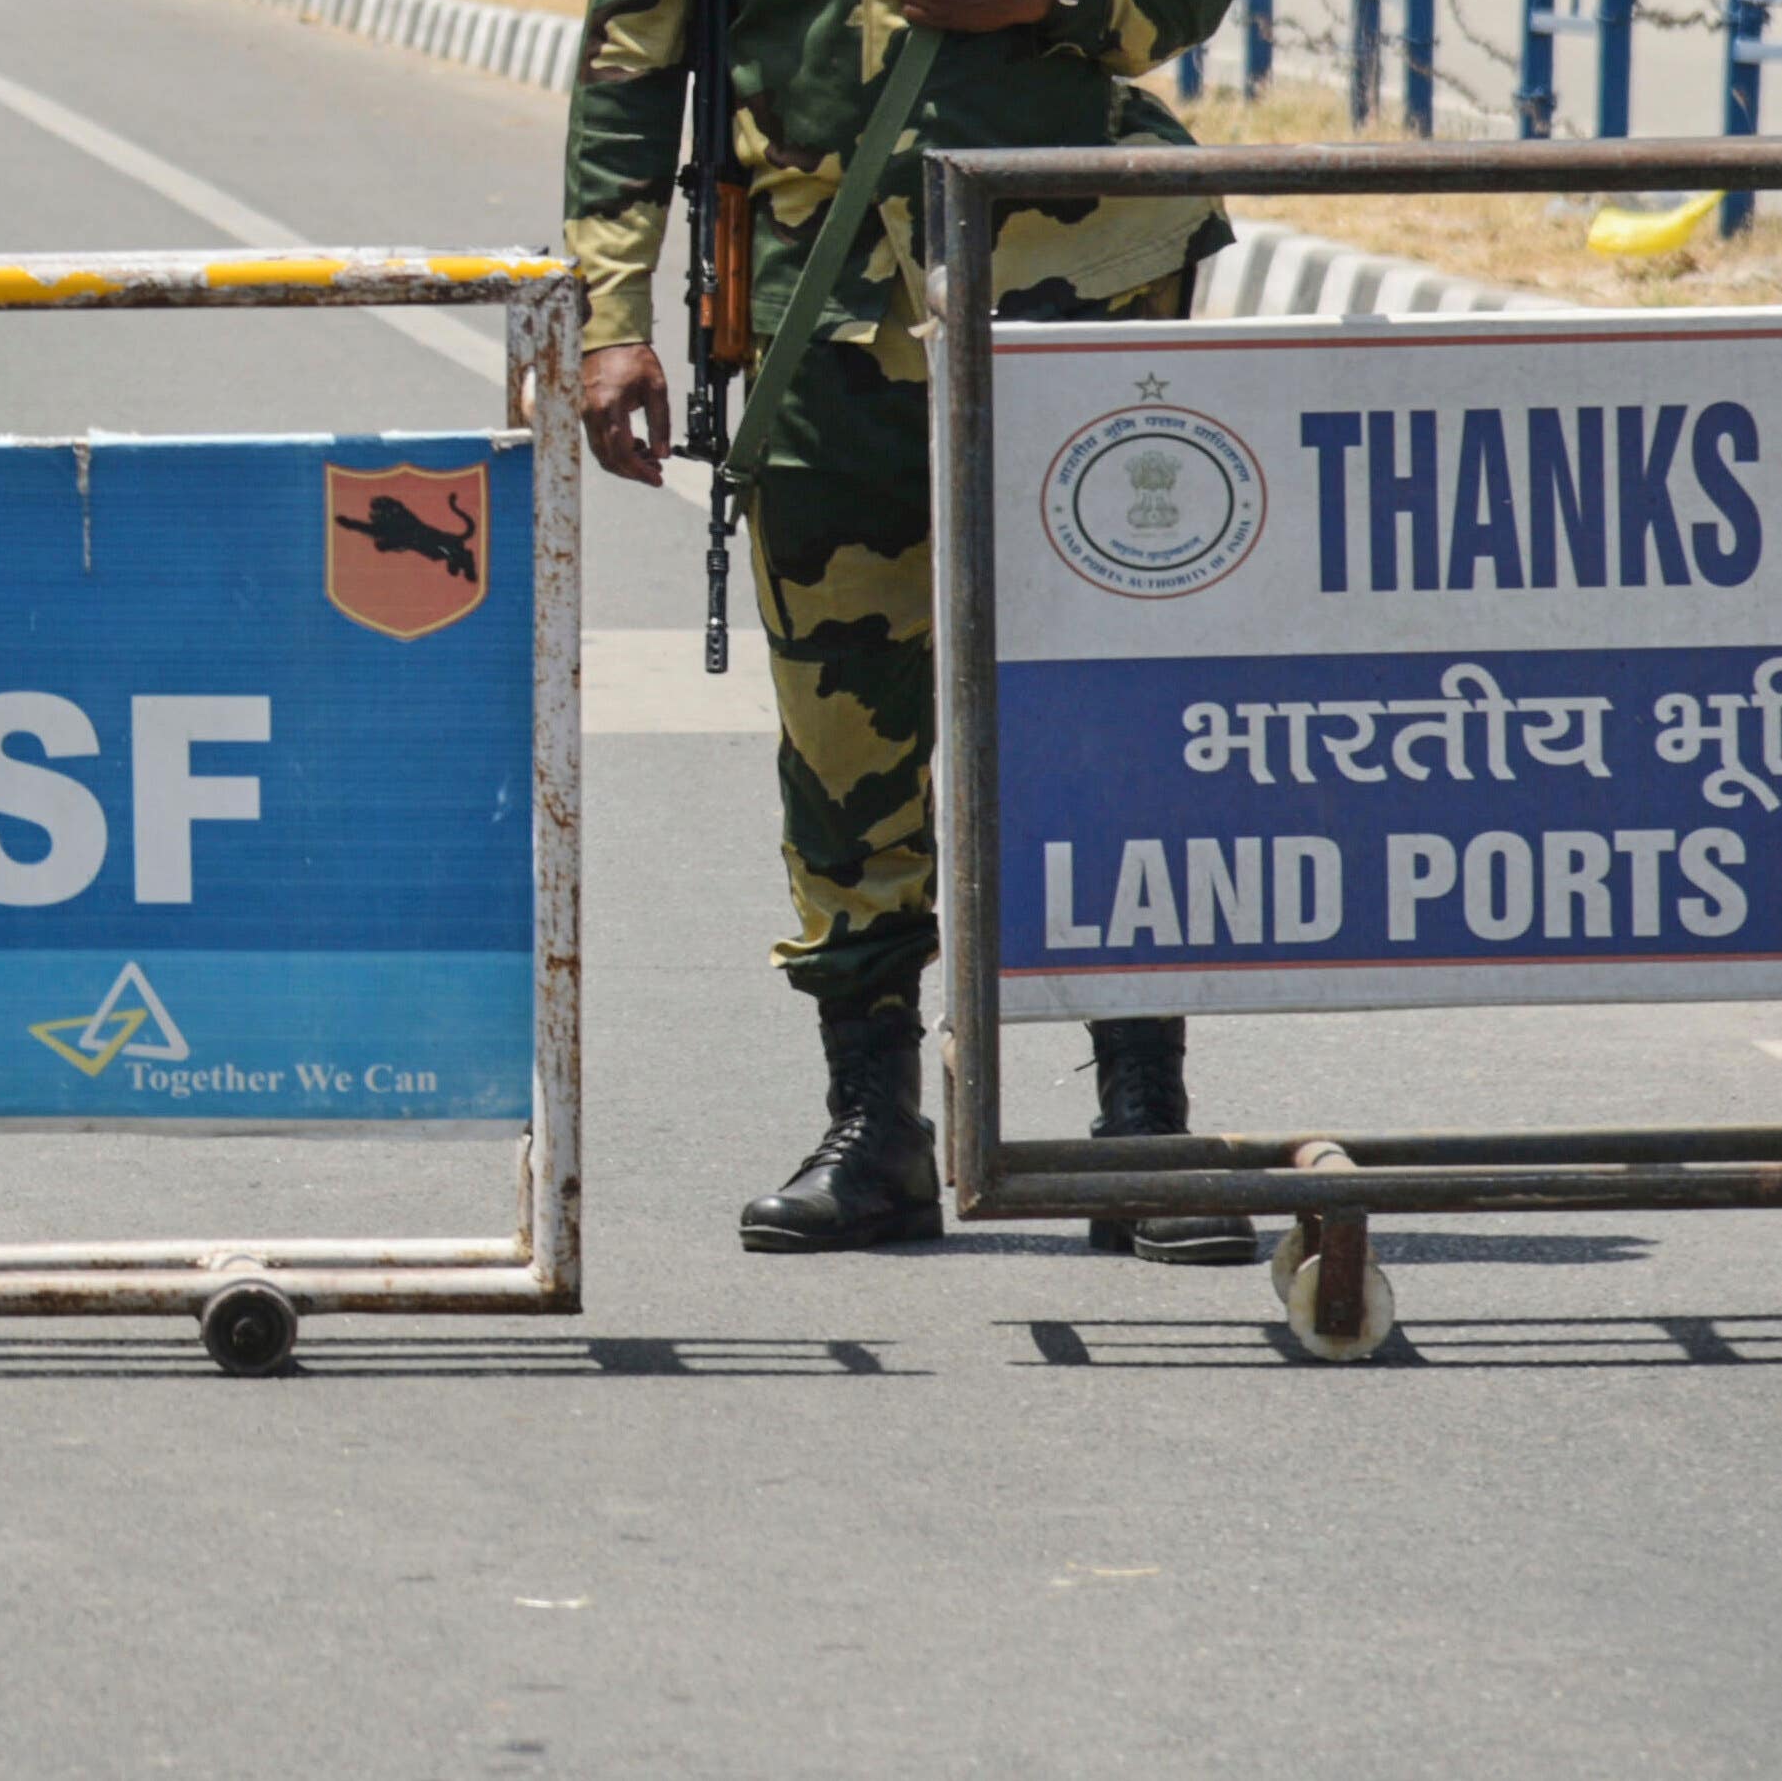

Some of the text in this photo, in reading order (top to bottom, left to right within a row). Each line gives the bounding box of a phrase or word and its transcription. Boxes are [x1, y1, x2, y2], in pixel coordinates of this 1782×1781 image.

[1058, 523, 1083, 556] LAND
[1080, 555, 1124, 584] PORTS
[1127, 569, 1208, 590] AUTHORITY
[1209, 555, 1226, 570] OF
[1226, 520, 1252, 554] INDIA
[1300, 401, 1762, 592] THANKS
[1181, 663, 1613, 785] भारतीय
[1044, 827, 1747, 949] LAND PORTS
[125, 1058, 437, 1098] Together We Can
